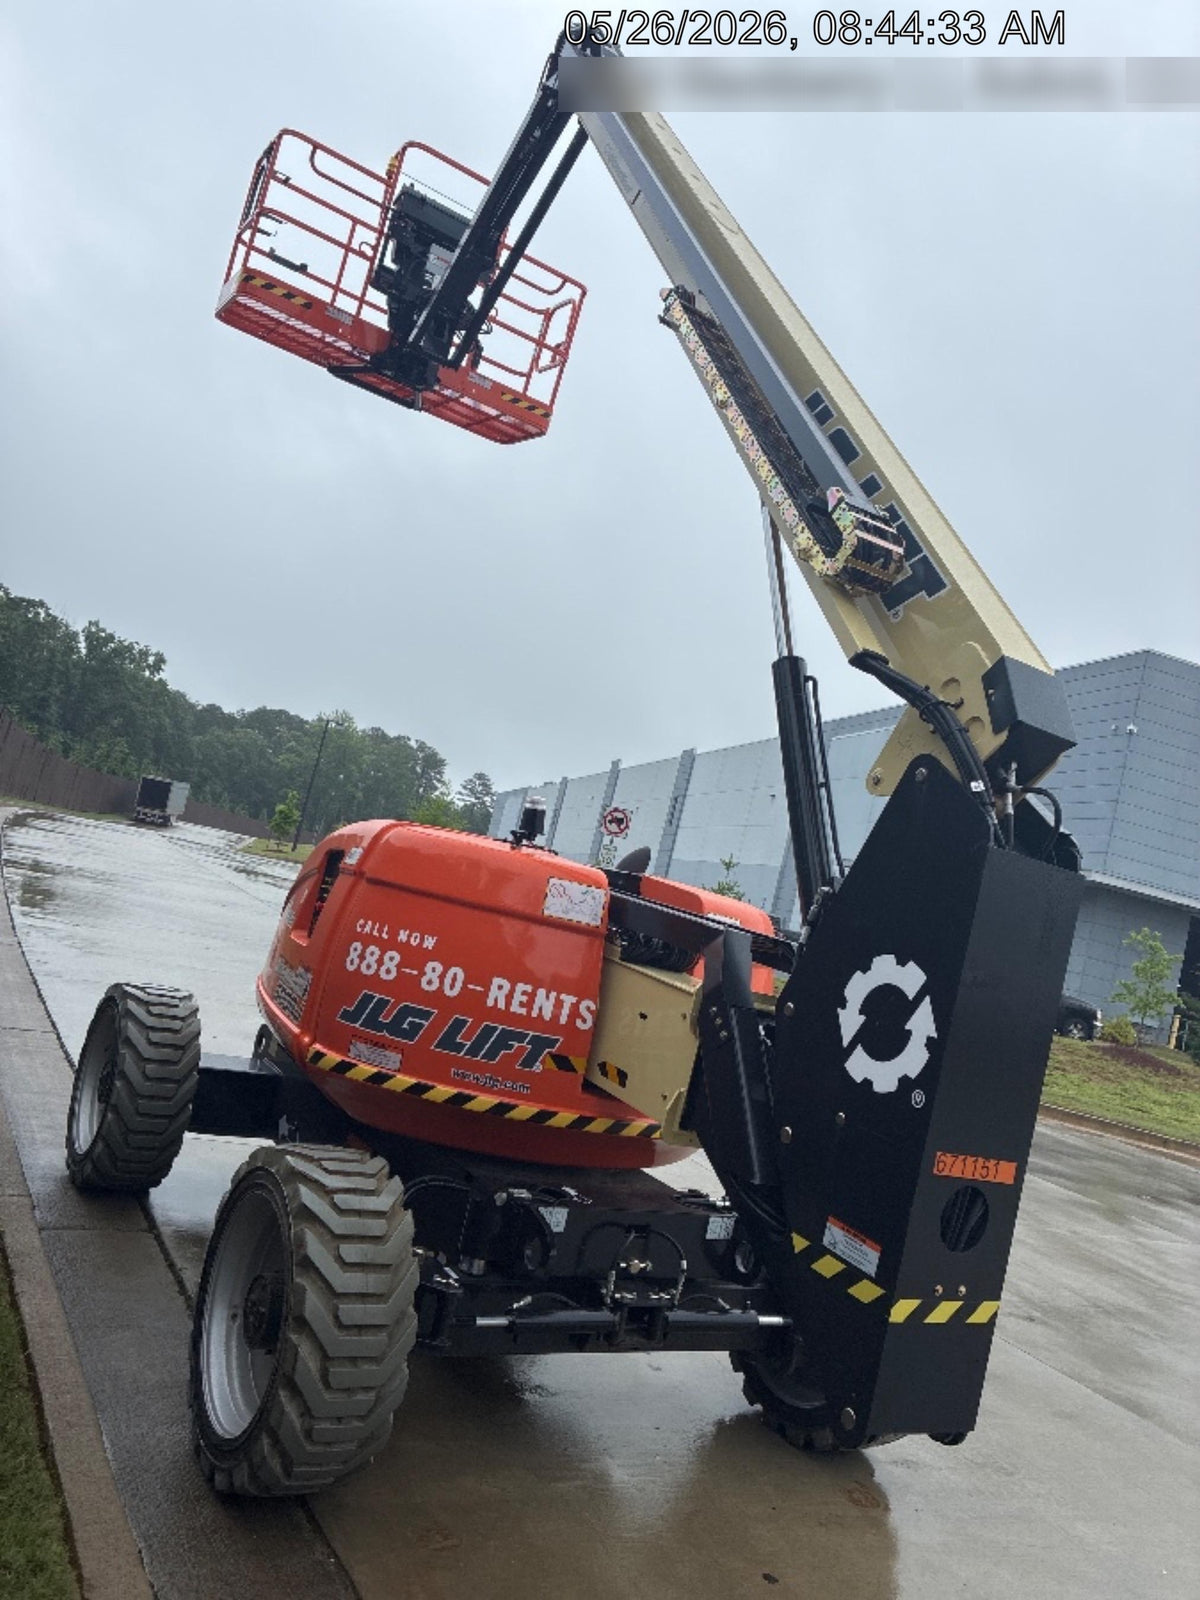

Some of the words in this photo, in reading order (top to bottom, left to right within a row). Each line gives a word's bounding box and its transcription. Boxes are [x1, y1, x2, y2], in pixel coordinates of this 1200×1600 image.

[355, 918, 390, 940] CALL
[397, 928, 438, 950] NOW
[345, 941, 597, 1031] 888-80-RENTS
[336, 989, 439, 1045] JLG
[430, 1014, 564, 1073] LIFT
[935, 1152, 1000, 1180] 671151
